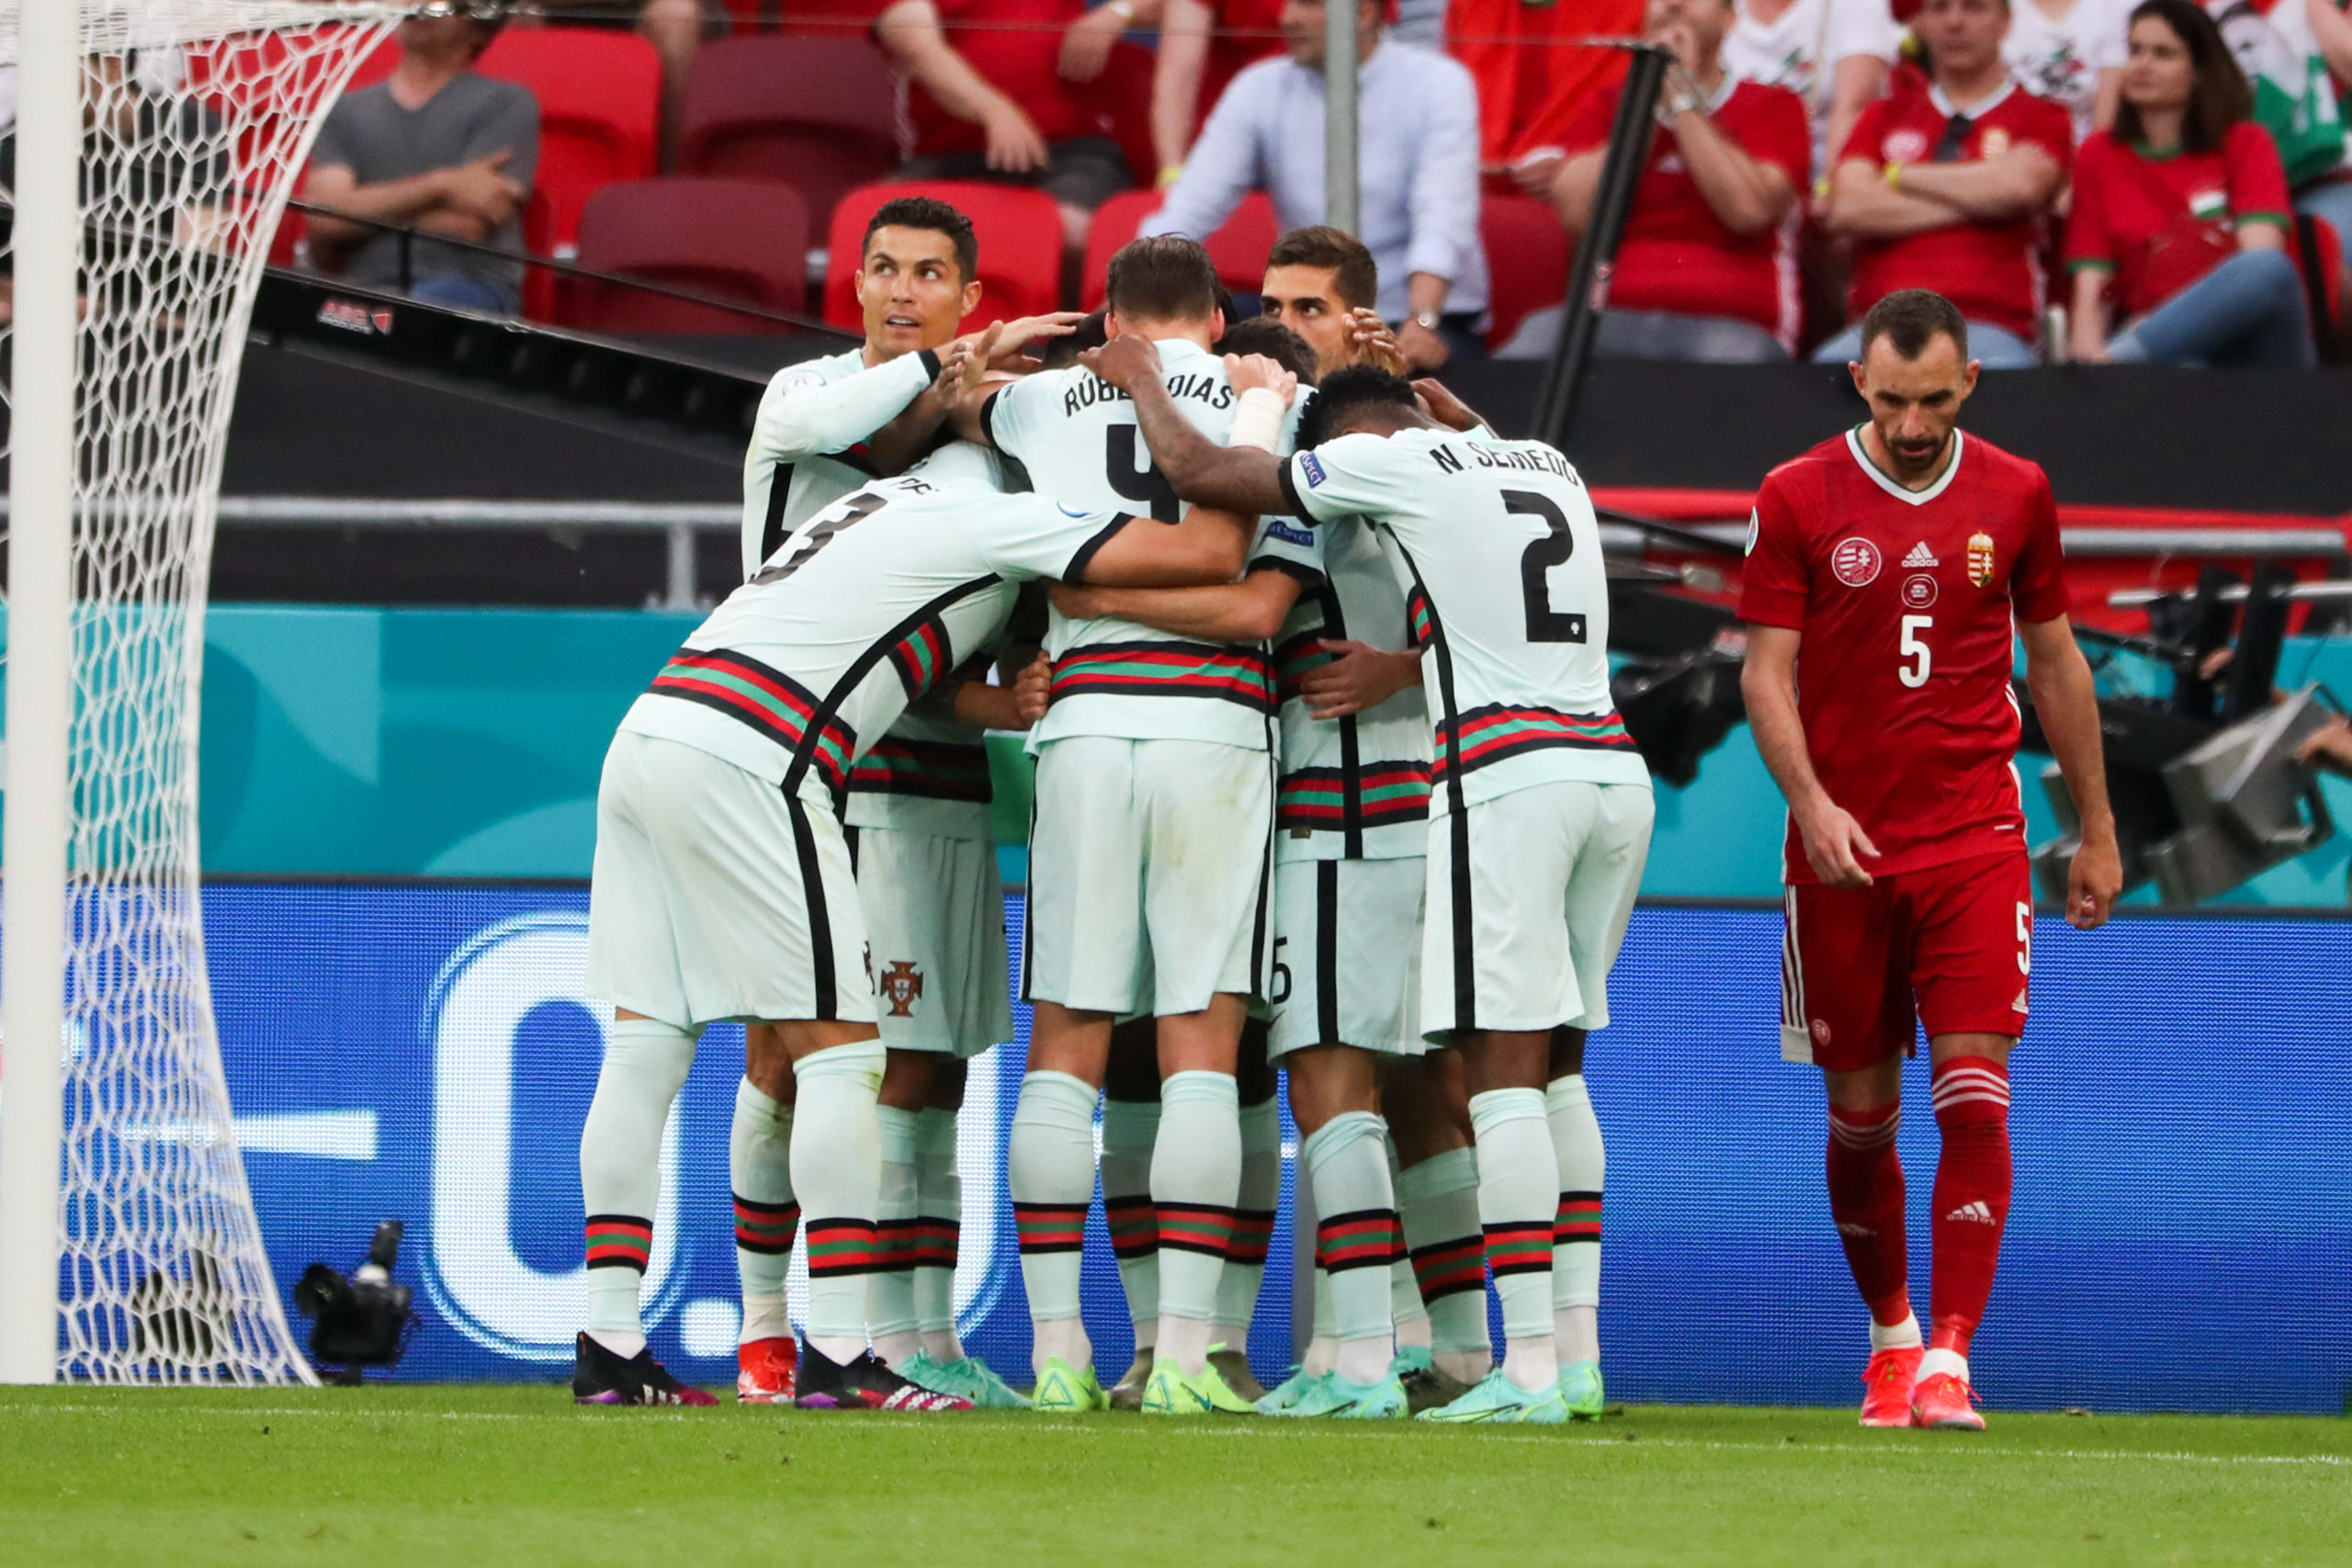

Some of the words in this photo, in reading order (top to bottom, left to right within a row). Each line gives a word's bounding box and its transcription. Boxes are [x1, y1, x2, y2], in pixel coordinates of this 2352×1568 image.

[1063, 371, 1135, 418] RÚB
[1167, 373, 1234, 410] DIAS
[1105, 423, 1181, 525] 4
[1499, 488, 1588, 645] 2
[1901, 558, 1939, 568] adidas
[1898, 614, 1933, 688] 5
[2016, 900, 2030, 976] 5
[1946, 1213, 1996, 1227] adidas
